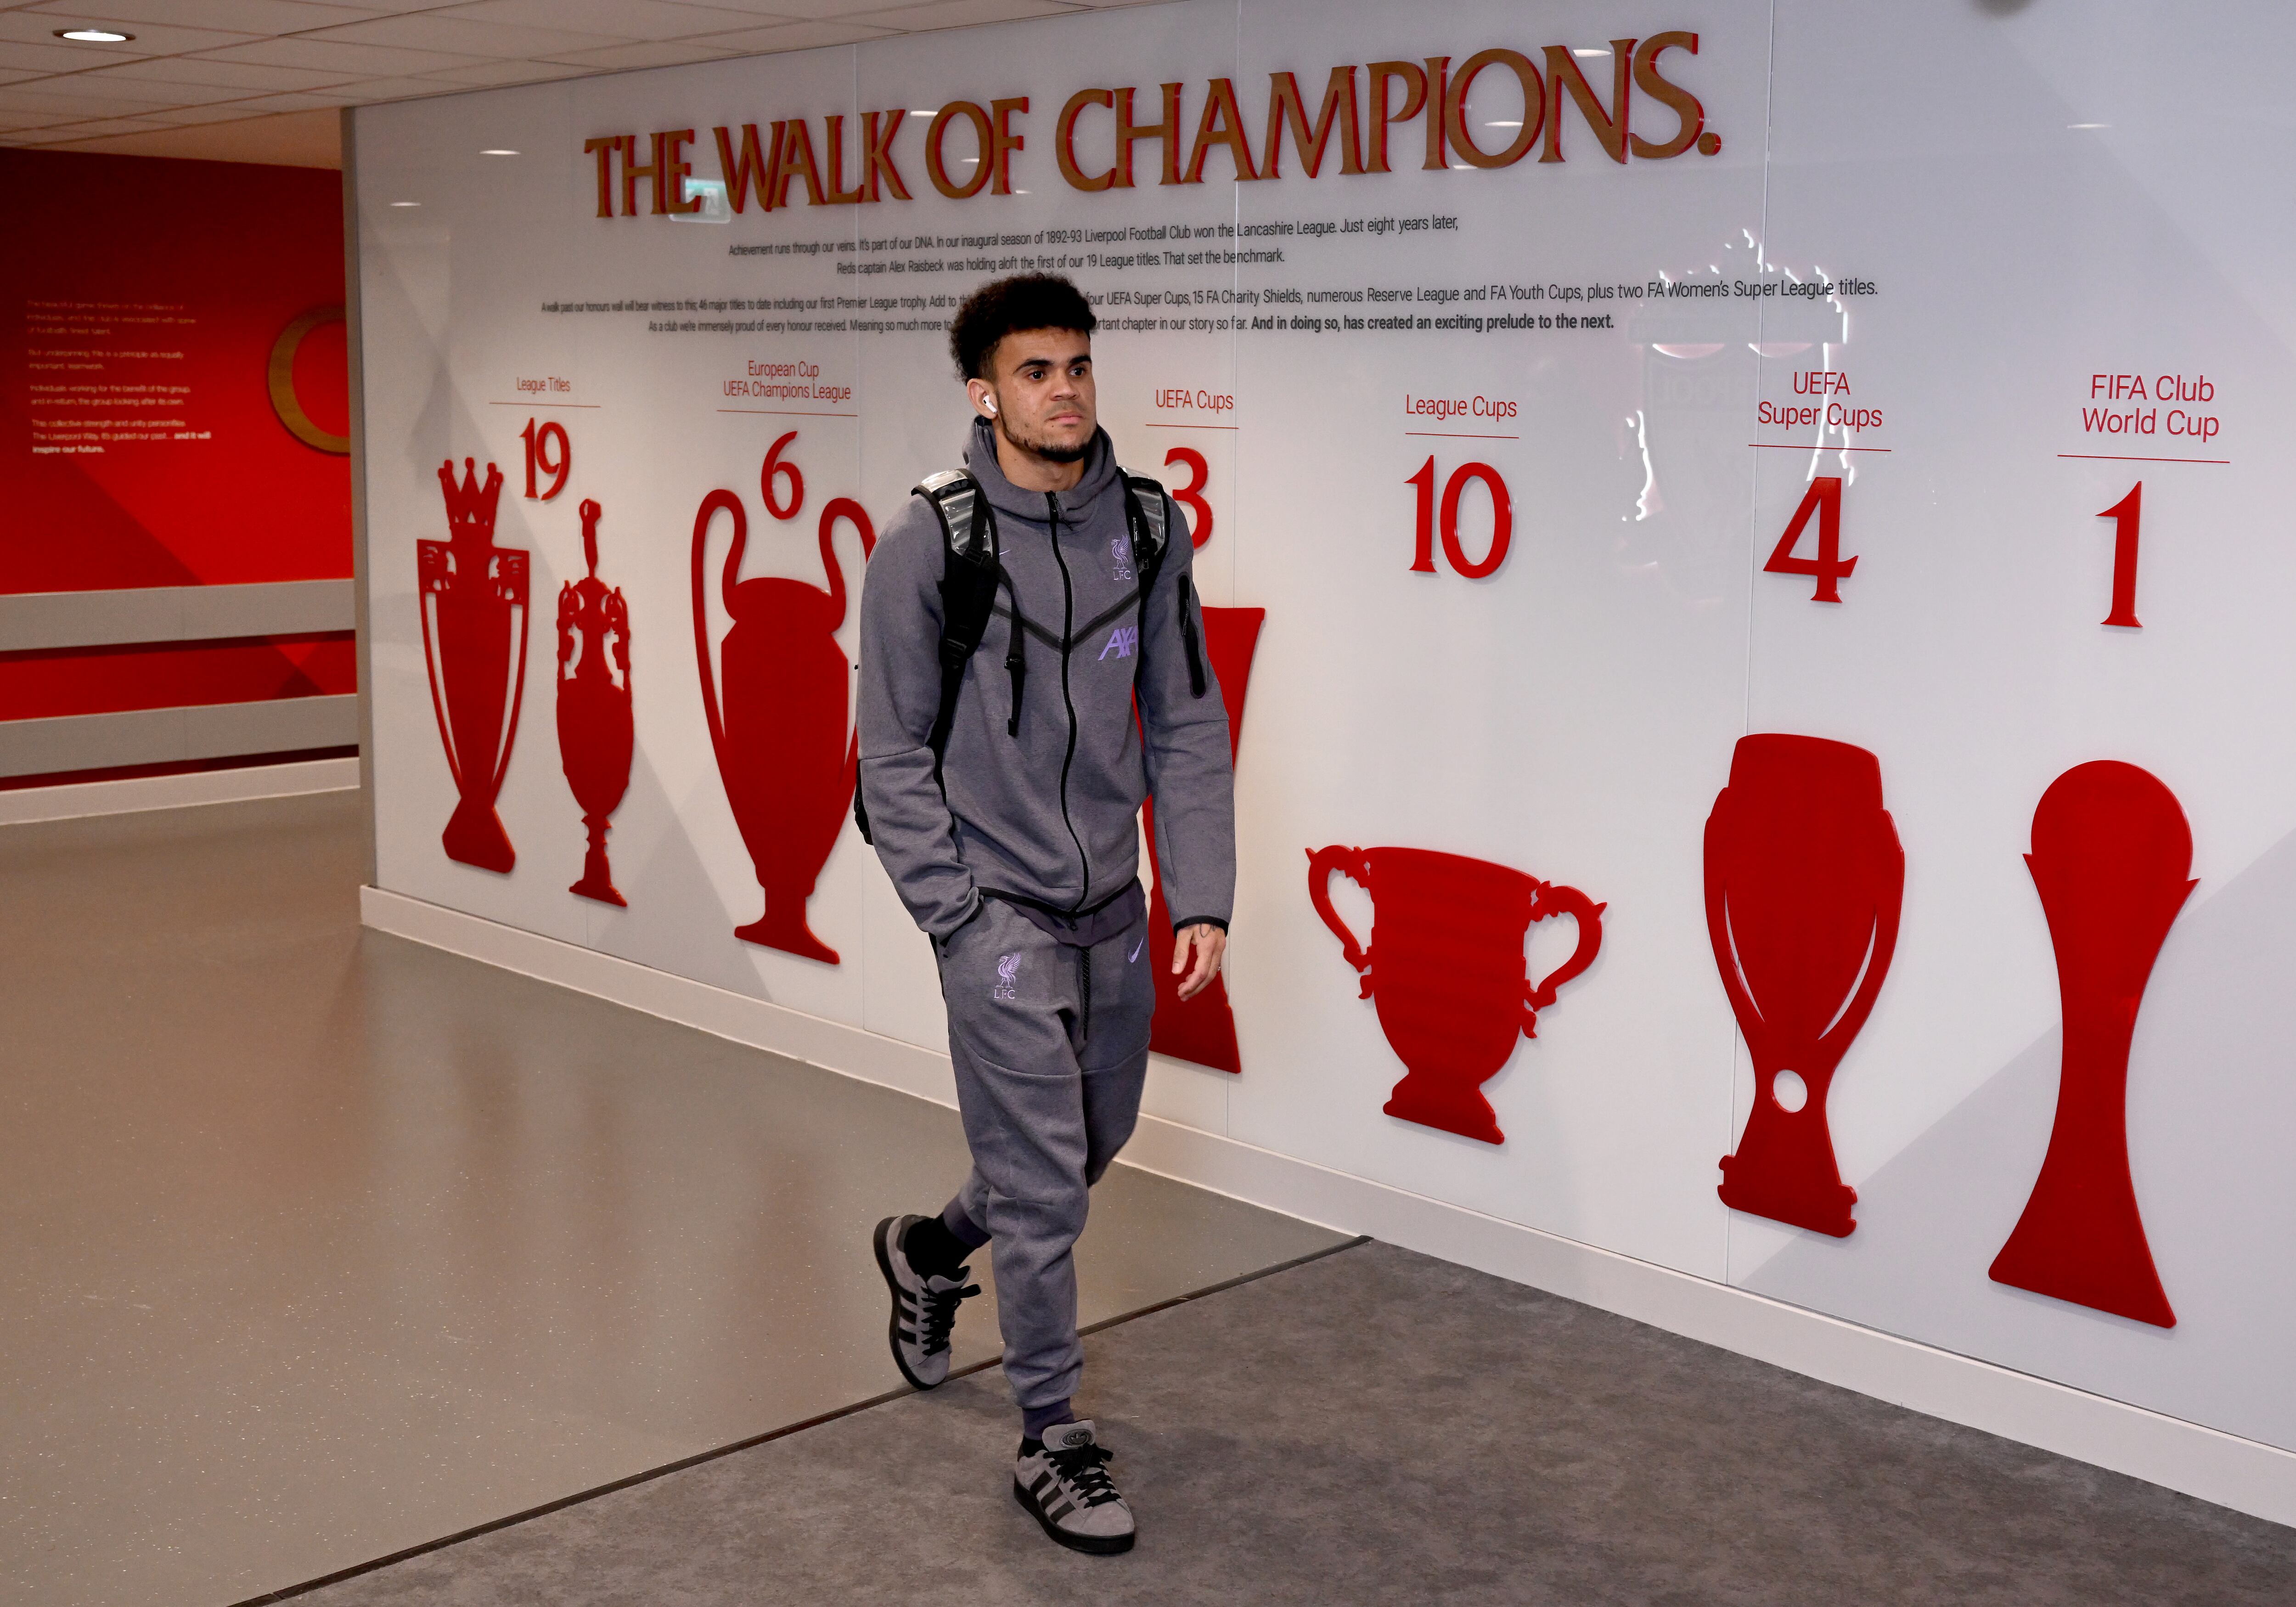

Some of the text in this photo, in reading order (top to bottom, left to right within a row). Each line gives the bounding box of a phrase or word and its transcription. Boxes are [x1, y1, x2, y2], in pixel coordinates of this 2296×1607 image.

[585, 31, 1722, 217] THE WALK OF CHAMPIONS.
[945, 237, 960, 248] our
[962, 233, 999, 249] inaugural
[1001, 235, 1031, 245] season
[1034, 231, 1044, 244] of
[1046, 230, 1081, 243] 1892-93
[1085, 227, 1126, 244] Liverpool
[1130, 226, 1166, 240] Football
[1170, 225, 1191, 239] Club
[1193, 227, 1215, 238] won
[1218, 223, 1234, 237] the
[1237, 221, 1294, 236] Lancashire
[1297, 221, 1337, 237] League.
[1340, 219, 1364, 232] Just
[1367, 217, 1395, 235] eight
[1399, 219, 1429, 235] years
[1433, 214, 1458, 231] later,
[837, 248, 1284, 276] Reds captain Alex Raisbeck was holding aloft the first of our 19 League titles. That set the benchmark.
[805, 300, 818, 309] our
[820, 296, 835, 309] first
[837, 296, 867, 308] Premier
[870, 297, 898, 311] League
[900, 295, 926, 310] trophy.
[929, 294, 945, 307] Add
[947, 296, 956, 307] to
[1107, 292, 1132, 305] UEFA
[1134, 292, 1162, 308] Super
[1165, 291, 1191, 307] Cups,
[1193, 291, 1204, 304] 15
[1207, 290, 1219, 303] FA
[1222, 289, 1260, 306] Charity
[1263, 288, 1303, 304] Shields,
[1307, 291, 1363, 302] numerous
[1367, 288, 1412, 302] Reserve
[1417, 287, 1459, 304] League
[1464, 285, 1486, 300] and
[1491, 285, 1507, 300] FA
[1509, 284, 1544, 300] Youth
[1549, 284, 1583, 303] Cups,
[1587, 283, 1614, 303] plus
[1618, 284, 1643, 298] two
[1648, 282, 1665, 298] FA
[1668, 280, 1729, 297] Women's
[1734, 280, 1778, 300] Super
[1781, 280, 1834, 299] League
[1839, 278, 1878, 295] titles.
[765, 322, 785, 334] every
[787, 320, 813, 331] honour
[814, 319, 847, 331] received.
[850, 319, 884, 334] Meaning
[885, 321, 895, 331] so
[896, 318, 920, 331] much
[919, 321, 941, 331] more
[1122, 316, 1157, 333] chapter
[1160, 317, 1168, 330] in
[1170, 320, 1186, 330] our
[1189, 317, 1214, 333] story
[1216, 320, 1228, 330] so
[1231, 316, 1247, 329] far.
[1251, 316, 1273, 329] And
[1277, 316, 1287, 329] in
[1290, 316, 1322, 333] doing
[1324, 319, 1340, 332] so,
[1344, 315, 1364, 329] has
[1367, 315, 1413, 329] created
[1417, 318, 1431, 329] an
[1435, 314, 1483, 333] exciting
[1487, 313, 1534, 333] prelude
[1538, 315, 1552, 329] to
[1555, 313, 1577, 328] the
[1581, 314, 1614, 328] next.
[517, 377, 570, 394] League Titles
[748, 361, 819, 380] European Cup
[1794, 372, 1850, 395] UEFA
[724, 381, 851, 403] UEFA Champions League
[1156, 389, 1233, 414] UEFA Cups
[2090, 375, 2214, 403] FIFA Club
[1406, 394, 1517, 422] League Cups
[1758, 402, 1882, 432] Super Cups
[2082, 407, 2219, 442] World Cup
[519, 417, 570, 501] 19
[761, 431, 804, 519] 6
[1164, 447, 1213, 549] 3
[1404, 455, 1512, 579] 10
[1763, 477, 1858, 602] 4
[2095, 481, 2143, 628] 1
[1098, 625, 1138, 660] AXA
